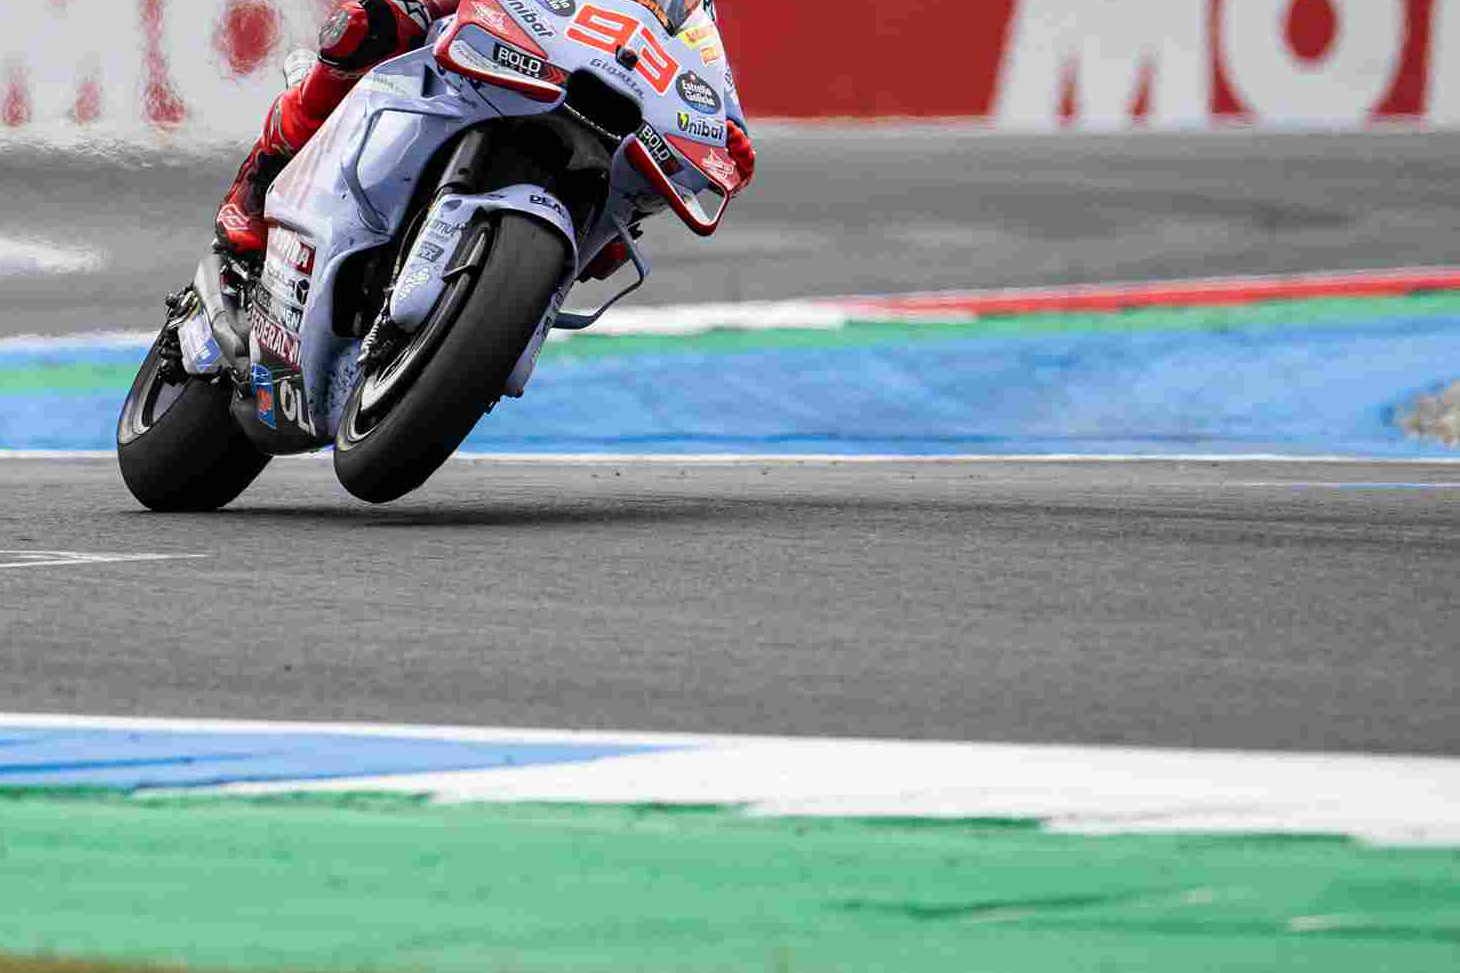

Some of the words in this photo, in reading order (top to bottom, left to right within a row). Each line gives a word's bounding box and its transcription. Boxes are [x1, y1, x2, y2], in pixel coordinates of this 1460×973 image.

[497, 45, 541, 74] BOLD
[564, 2, 681, 97] 93
[677, 112, 725, 141] Unibat
[642, 125, 670, 162] BOLD
